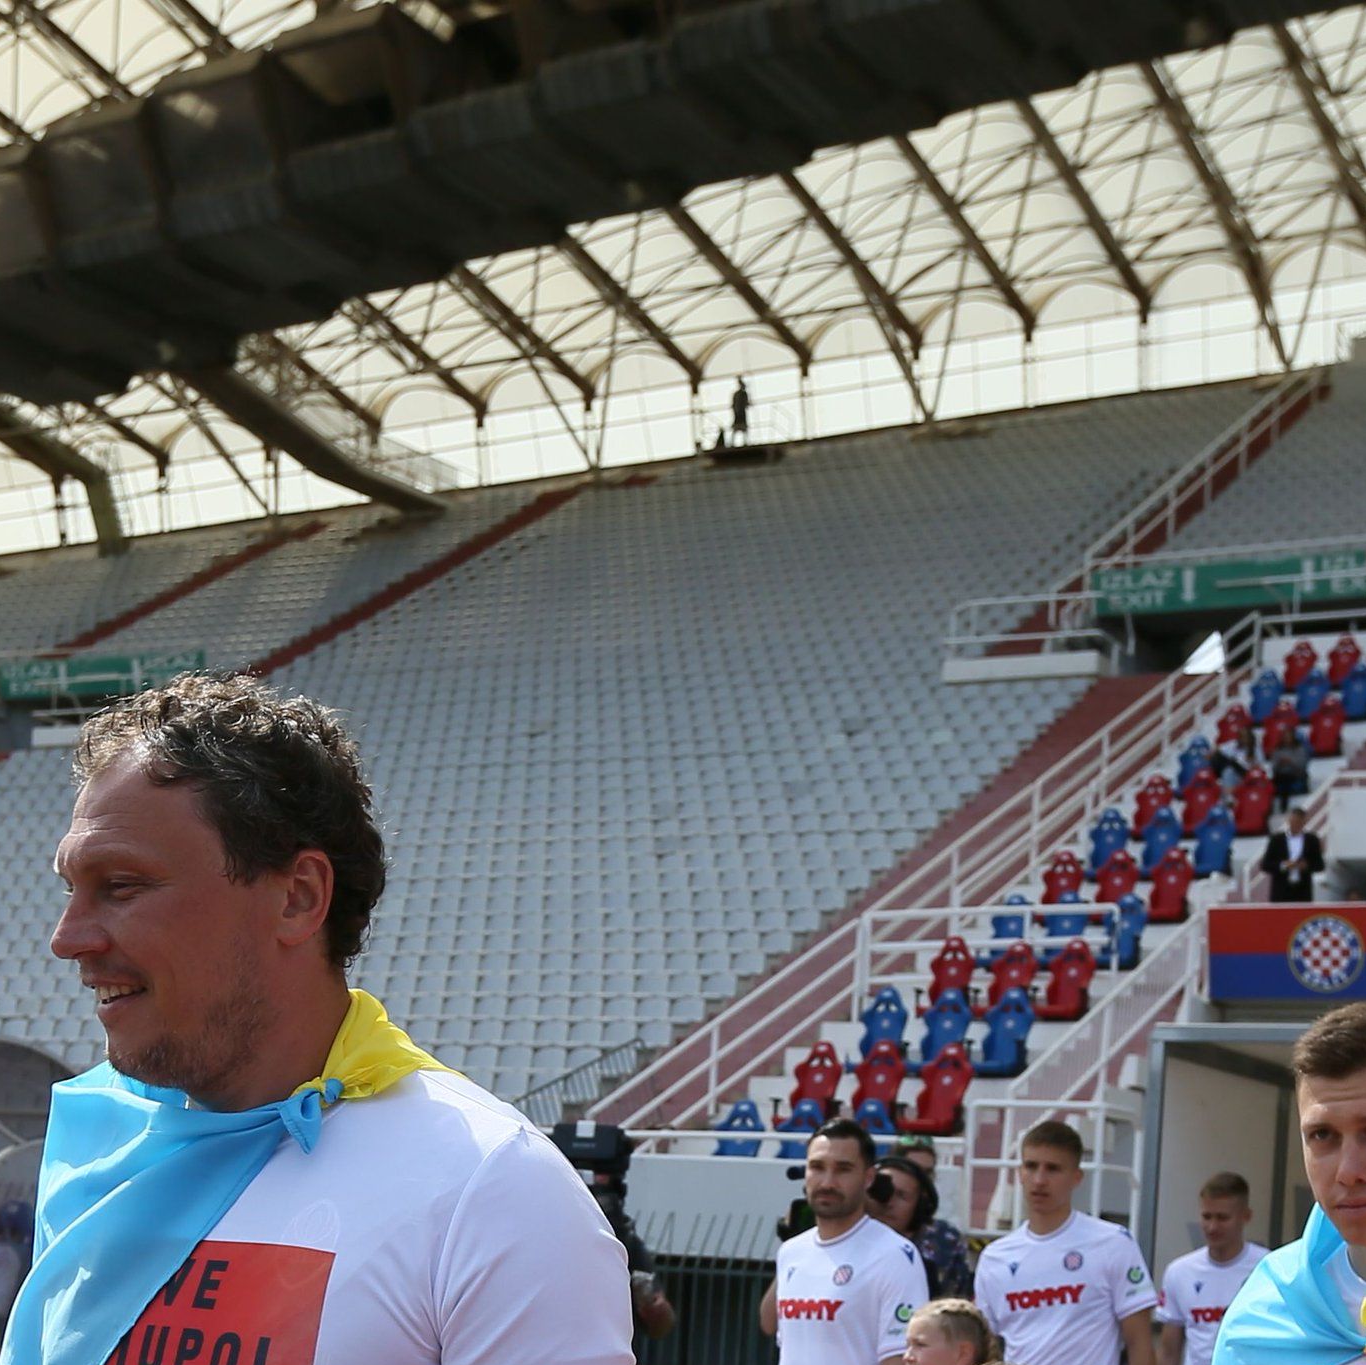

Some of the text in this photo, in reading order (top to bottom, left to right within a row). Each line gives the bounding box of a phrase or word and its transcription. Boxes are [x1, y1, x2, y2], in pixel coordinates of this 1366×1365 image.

[164, 1258, 230, 1310] VE
[1006, 1283, 1085, 1311] TOMMY
[778, 1299, 844, 1321] TOMMY
